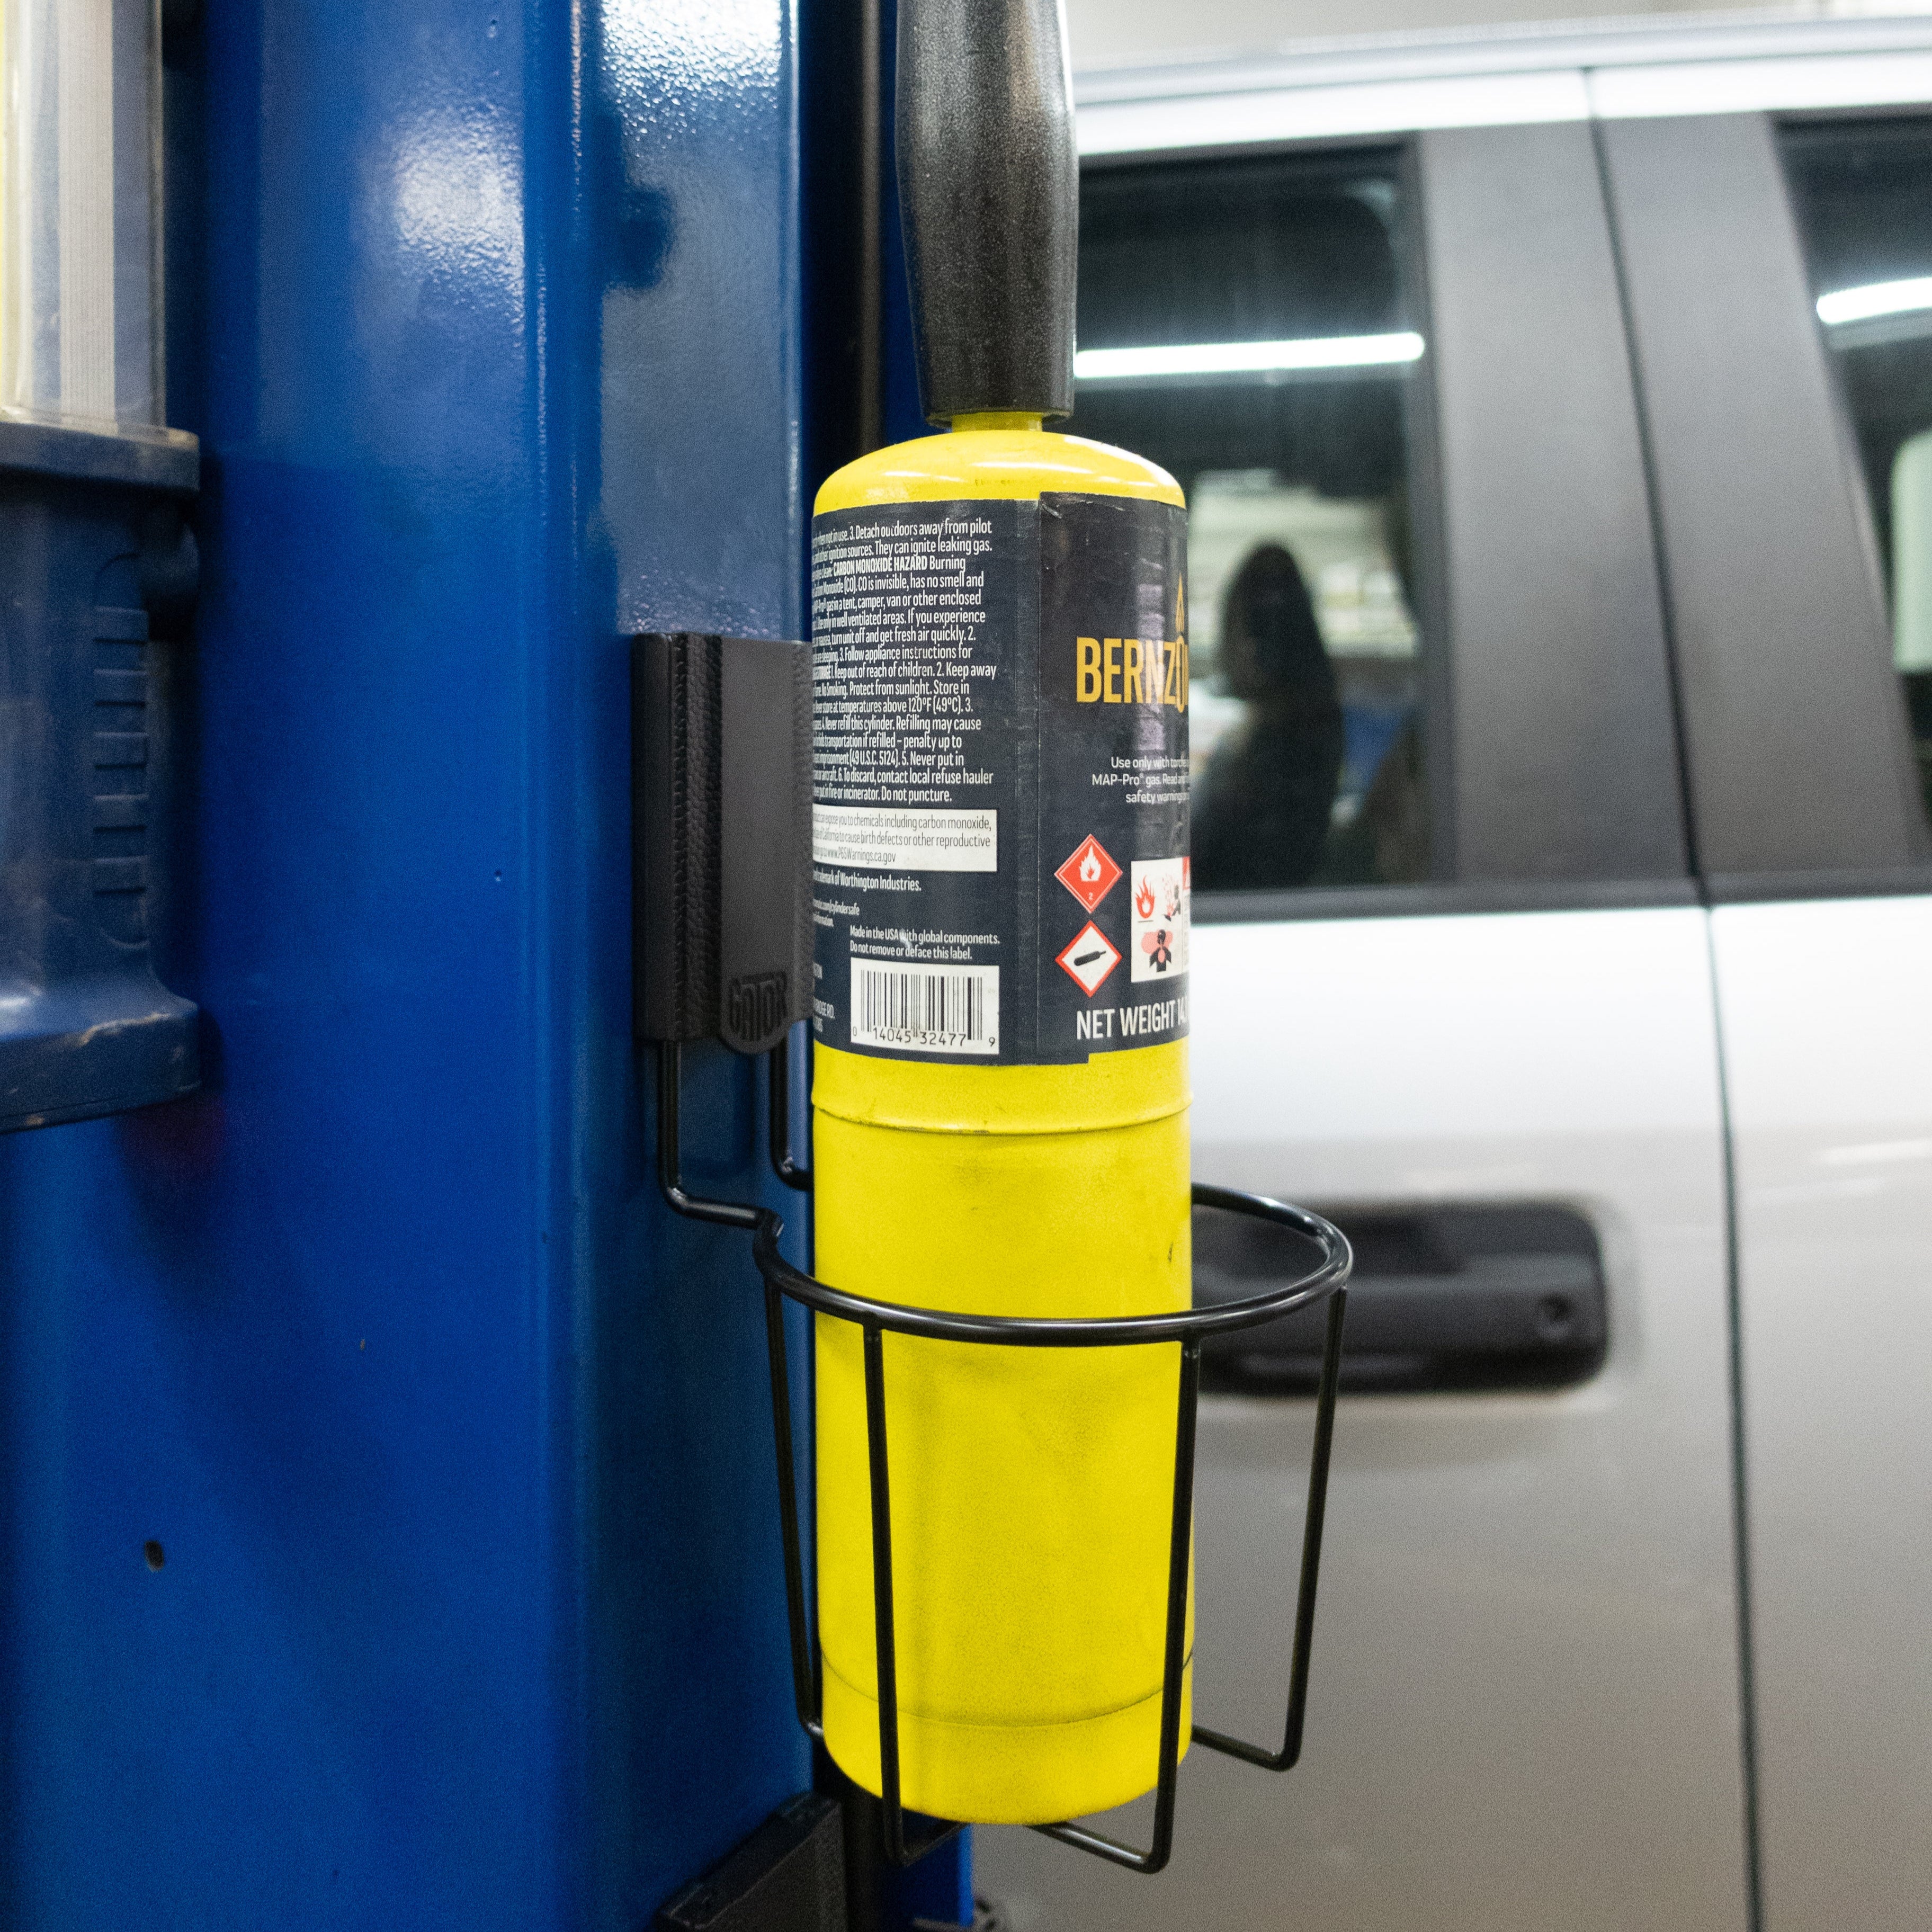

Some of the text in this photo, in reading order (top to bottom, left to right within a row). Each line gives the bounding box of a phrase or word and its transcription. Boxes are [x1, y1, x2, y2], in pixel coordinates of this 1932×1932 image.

[834, 529, 838, 542] in
[838, 530, 849, 541] use.
[849, 526, 855, 540] 3.
[856, 523, 879, 539] Detach
[881, 520, 917, 536] outdoors
[919, 523, 942, 538] away
[945, 518, 968, 535] from
[970, 518, 991, 537] pilot
[847, 536, 992, 557] sources. They can ignite leaking gas.
[834, 561, 854, 576] CARBON
[856, 557, 892, 574] MONOXIDE
[894, 556, 927, 570] HAZARD
[929, 554, 965, 572] Burning
[844, 571, 984, 594] (CO). CO is invisible, has no smell and
[843, 589, 981, 611] tent, camper, van or other enclosed
[837, 611, 847, 627] well
[848, 610, 881, 626] ventilated
[883, 613, 906, 624] areas.
[908, 608, 915, 623] If
[916, 614, 932, 627] you
[933, 608, 986, 626] experience
[831, 632, 842, 645] turn
[843, 629, 854, 644] unit
[855, 627, 864, 644] off
[866, 628, 879, 643] and
[880, 629, 893, 646] get
[895, 625, 916, 641] fresh
[918, 627, 928, 641] air
[931, 626, 966, 643] quickly.
[968, 625, 976, 640] 2.
[839, 647, 844, 661] 3.
[845, 646, 864, 660] Follow
[865, 645, 900, 663] appliance
[902, 645, 956, 659] instructions
[959, 642, 973, 658] for
[847, 666, 858, 678] out
[859, 662, 866, 677] of
[866, 664, 887, 678] reach
[889, 663, 897, 677] of
[898, 663, 935, 677] children.
[937, 662, 944, 676] 2.
[946, 664, 969, 679] Keep
[971, 665, 997, 679] away
[1076, 636, 1188, 713] BERNZO
[827, 681, 848, 699] Smoking.
[849, 682, 874, 695] Protect
[875, 680, 894, 695] from
[896, 679, 932, 697] sunlight.
[934, 679, 959, 694] Store
[961, 679, 969, 694] in
[833, 701, 838, 713] at
[839, 701, 882, 714] temperatures
[883, 697, 907, 712] above
[965, 698, 973, 712] 3.
[838, 714, 851, 730] refill
[851, 715, 863, 730] this
[864, 715, 894, 733] cylinder.
[897, 714, 930, 732] Refilling
[932, 719, 952, 733] may
[954, 718, 981, 729] cause
[825, 732, 862, 751] transportation
[863, 733, 868, 746] if
[869, 732, 896, 747] refilled
[904, 731, 937, 751] penalty
[938, 736, 950, 750] up
[952, 735, 962, 747] to
[849, 748, 964, 768] (49 U.S.C. 5124). 5. Never put in
[1111, 757, 1130, 768] Use
[1132, 755, 1152, 770] only
[1153, 755, 1169, 768] with
[838, 767, 843, 782] 6.
[844, 768, 849, 782] To
[851, 766, 876, 785] discard,
[877, 770, 908, 783] contact
[910, 768, 930, 783] local
[932, 768, 961, 783] refuse
[963, 768, 994, 784] hauler
[1146, 776, 1161, 788] gas.
[1162, 773, 1177, 784] Read
[844, 784, 952, 804] incinerator. Do not puncture.
[1126, 789, 1156, 804] safety
[854, 813, 991, 831] chemicals including carbon monoxide,
[840, 830, 990, 849] to cause birth defects or other reproductive
[835, 870, 840, 885] of
[840, 872, 878, 892] Worthington
[880, 874, 922, 892] Industries.
[1088, 892, 1093, 900] 2
[850, 925, 1000, 946] Made in the USA with global components.
[850, 941, 972, 960] Do not remove or deface this label.
[1077, 1008, 1115, 1040] NET
[1120, 1000, 1176, 1036] WEIGHT
[853, 1026, 996, 1047] 0 14045 32477 9
